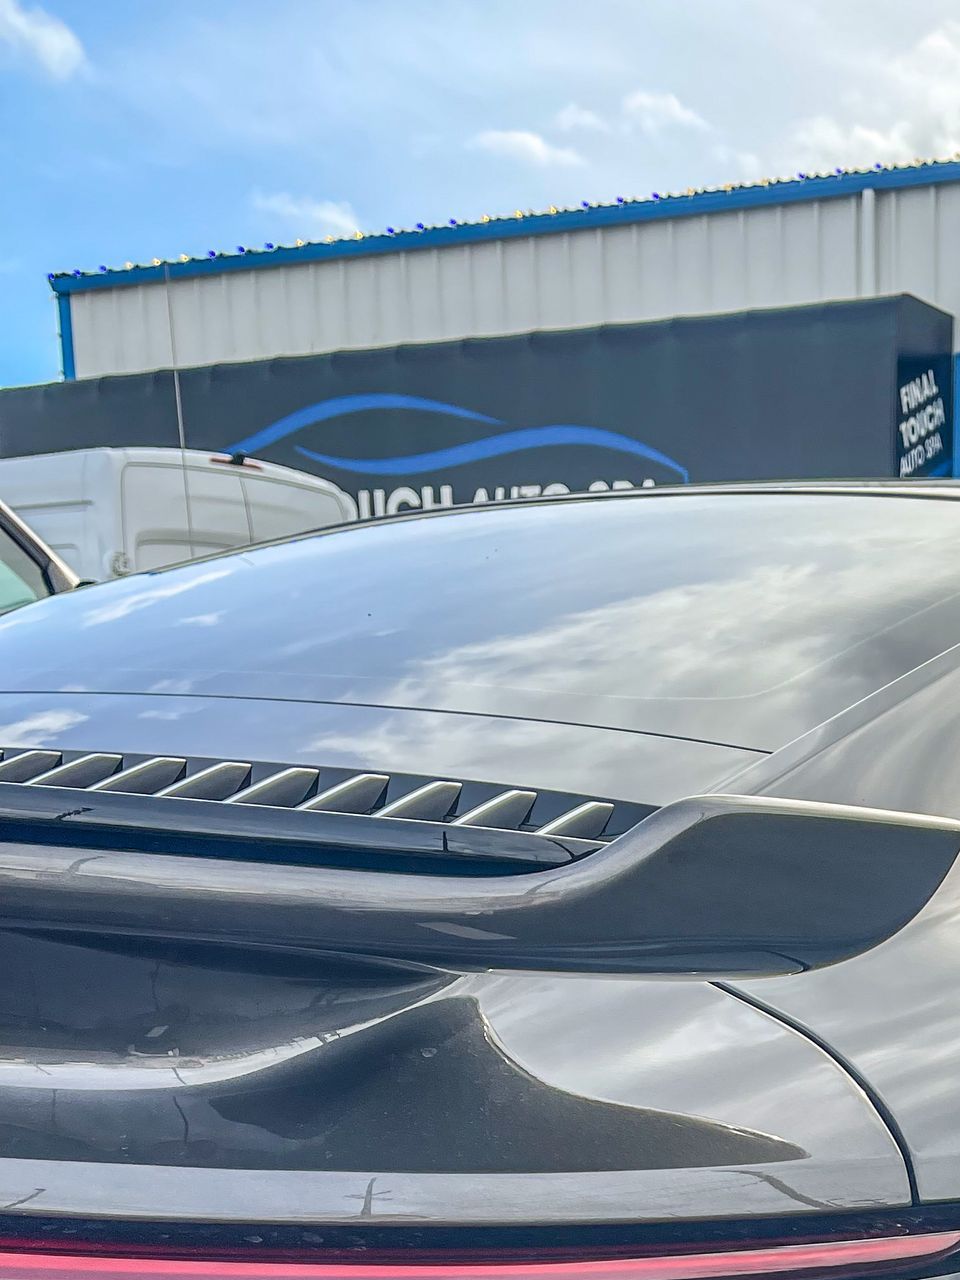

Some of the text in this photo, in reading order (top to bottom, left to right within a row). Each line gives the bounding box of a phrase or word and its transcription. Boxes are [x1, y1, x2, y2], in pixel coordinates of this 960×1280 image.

[900, 369, 938, 414] FINAL
[899, 398, 945, 448] TOUCH
[900, 433, 943, 478] AUTO SPA
